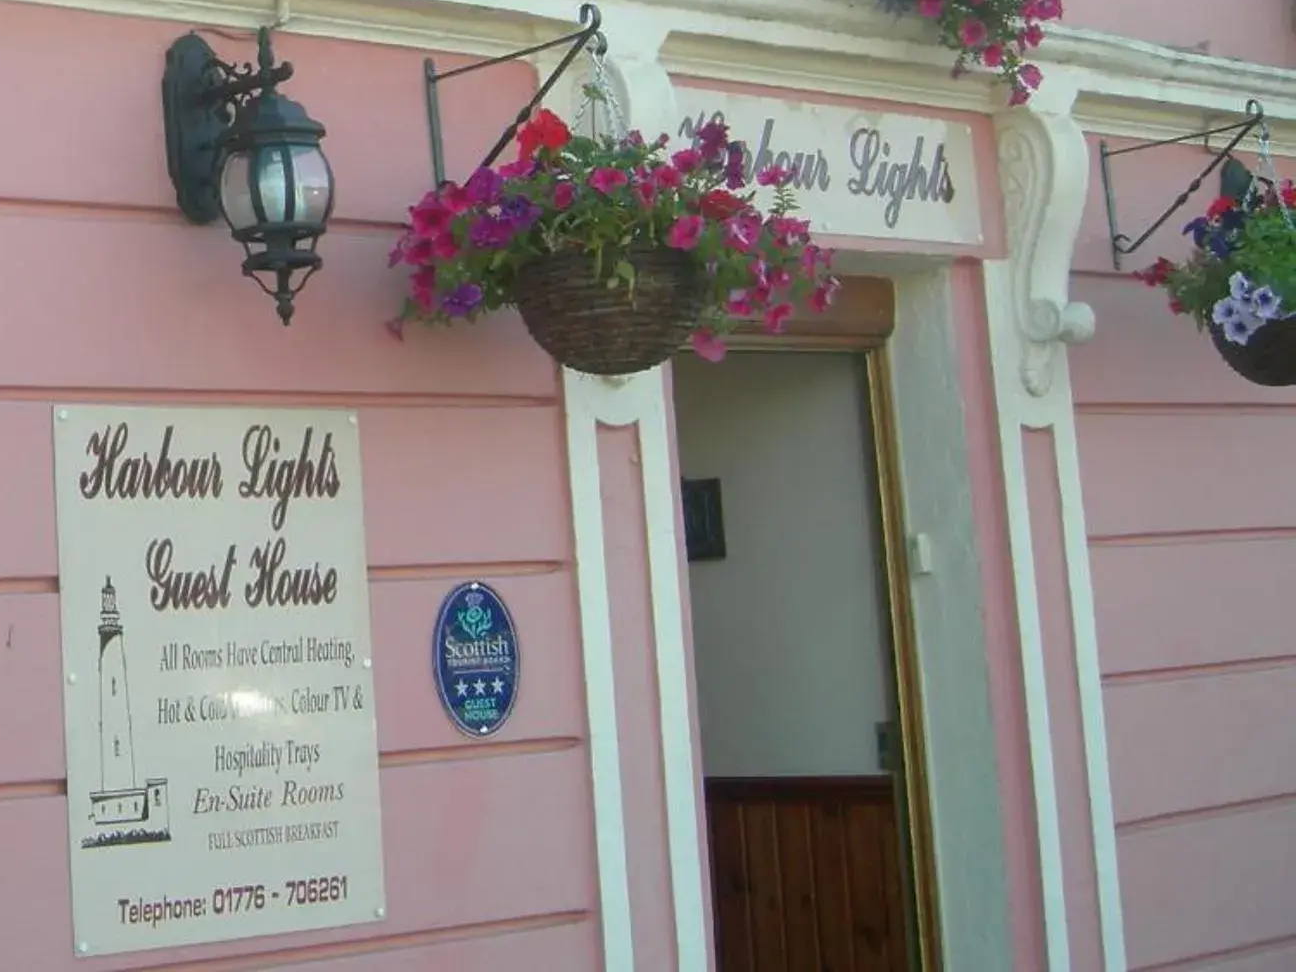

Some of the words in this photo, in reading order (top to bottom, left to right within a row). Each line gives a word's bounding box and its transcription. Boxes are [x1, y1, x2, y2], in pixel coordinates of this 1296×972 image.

[678, 110, 830, 192] bour
[847, 128, 956, 228] Lights
[80, 422, 223, 499] Harbour
[239, 424, 340, 531] Lights
[145, 538, 237, 611] Guest
[244, 537, 337, 608] House
[160, 642, 178, 671] All
[182, 643, 222, 670] Rooms
[227, 641, 258, 667] Have
[260, 636, 303, 665] Central
[445, 634, 509, 659] Scottish
[158, 697, 181, 724] Hot
[184, 697, 196, 722] &
[291, 686, 330, 714] Colour
[333, 685, 350, 711] TV
[352, 684, 363, 710] &
[465, 697, 496, 709] GUEST
[214, 740, 282, 777] Hospitality
[286, 739, 321, 772] Trays
[193, 785, 272, 814] En-Suite
[280, 779, 344, 807] Rooms
[208, 830, 232, 851] FULL
[234, 825, 283, 848] SCOTTISH
[285, 820, 339, 844] BREAKFAST
[117, 895, 207, 928] Telephone:
[212, 884, 265, 914] 01776
[286, 876, 348, 906] 706261
